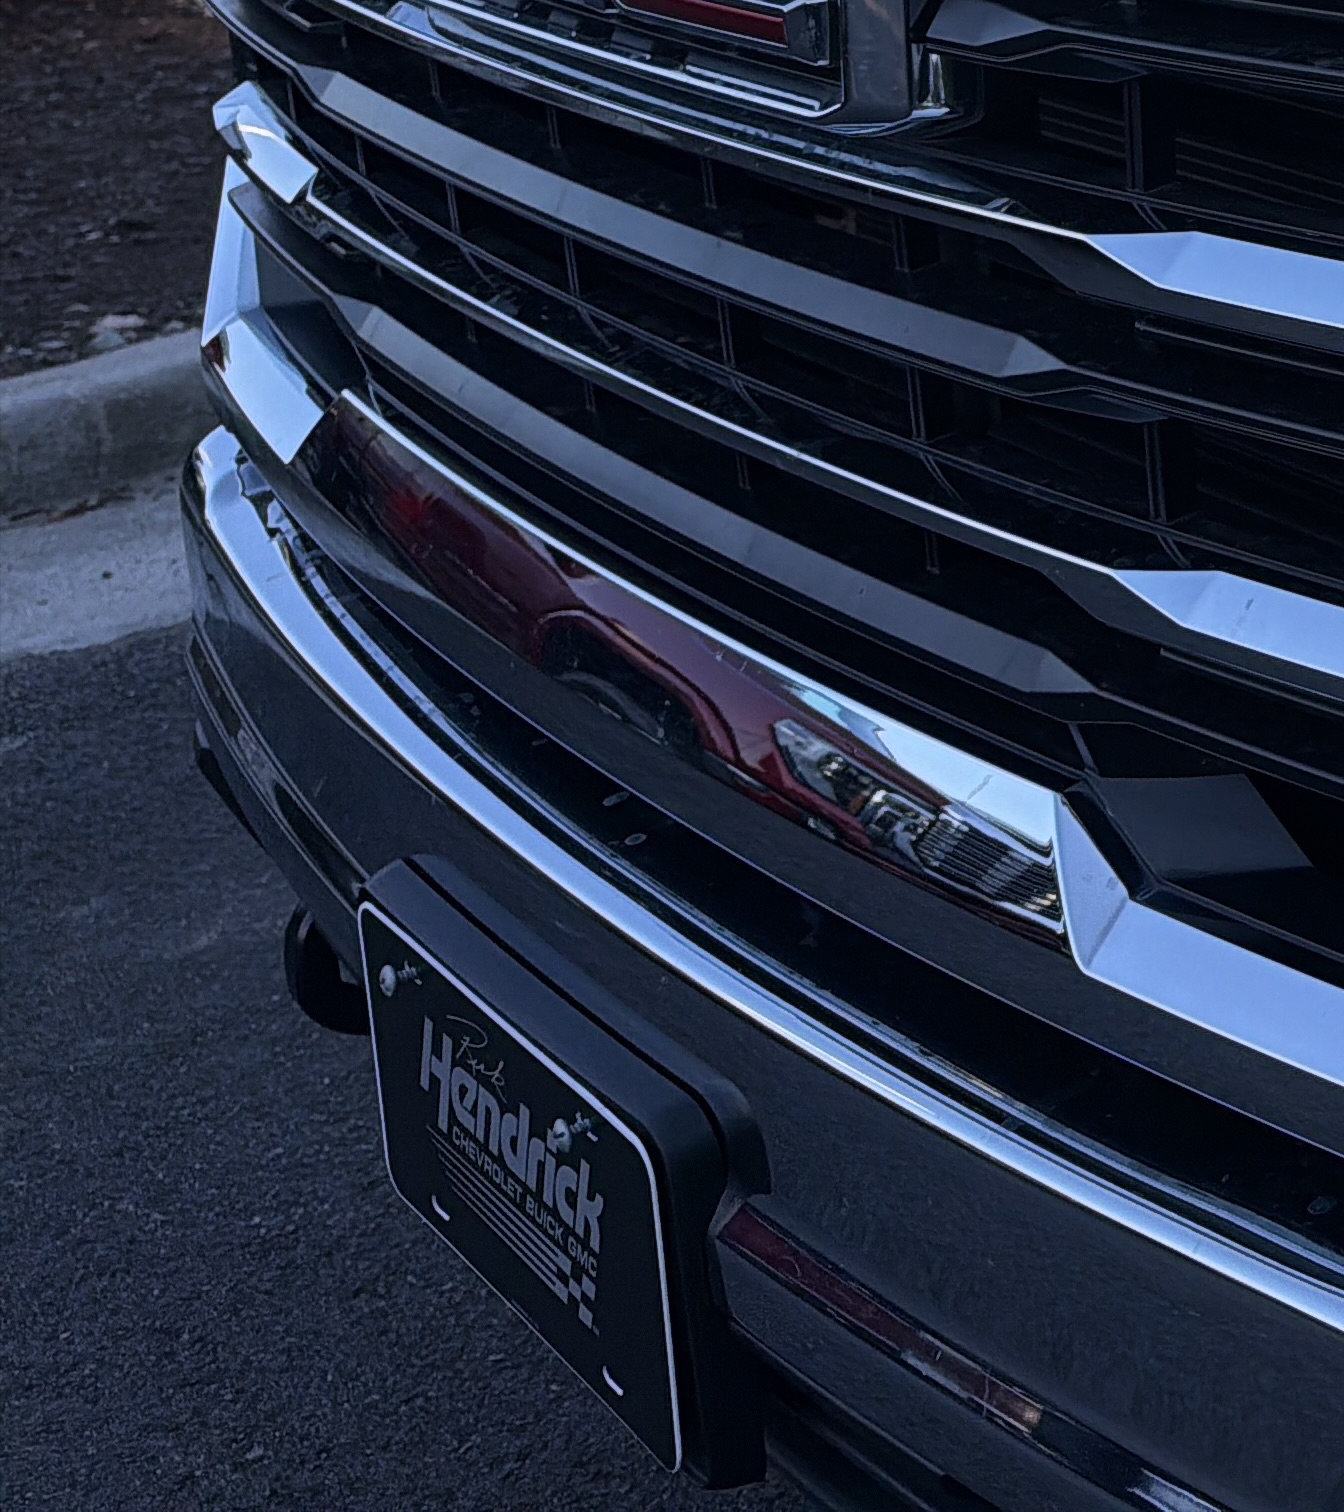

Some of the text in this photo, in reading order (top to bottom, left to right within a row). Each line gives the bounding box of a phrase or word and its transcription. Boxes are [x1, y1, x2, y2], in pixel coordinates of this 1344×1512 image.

[419, 1015, 604, 1255] Hendrick
[452, 1125, 598, 1278] CHEVROLET BUICK GMC
